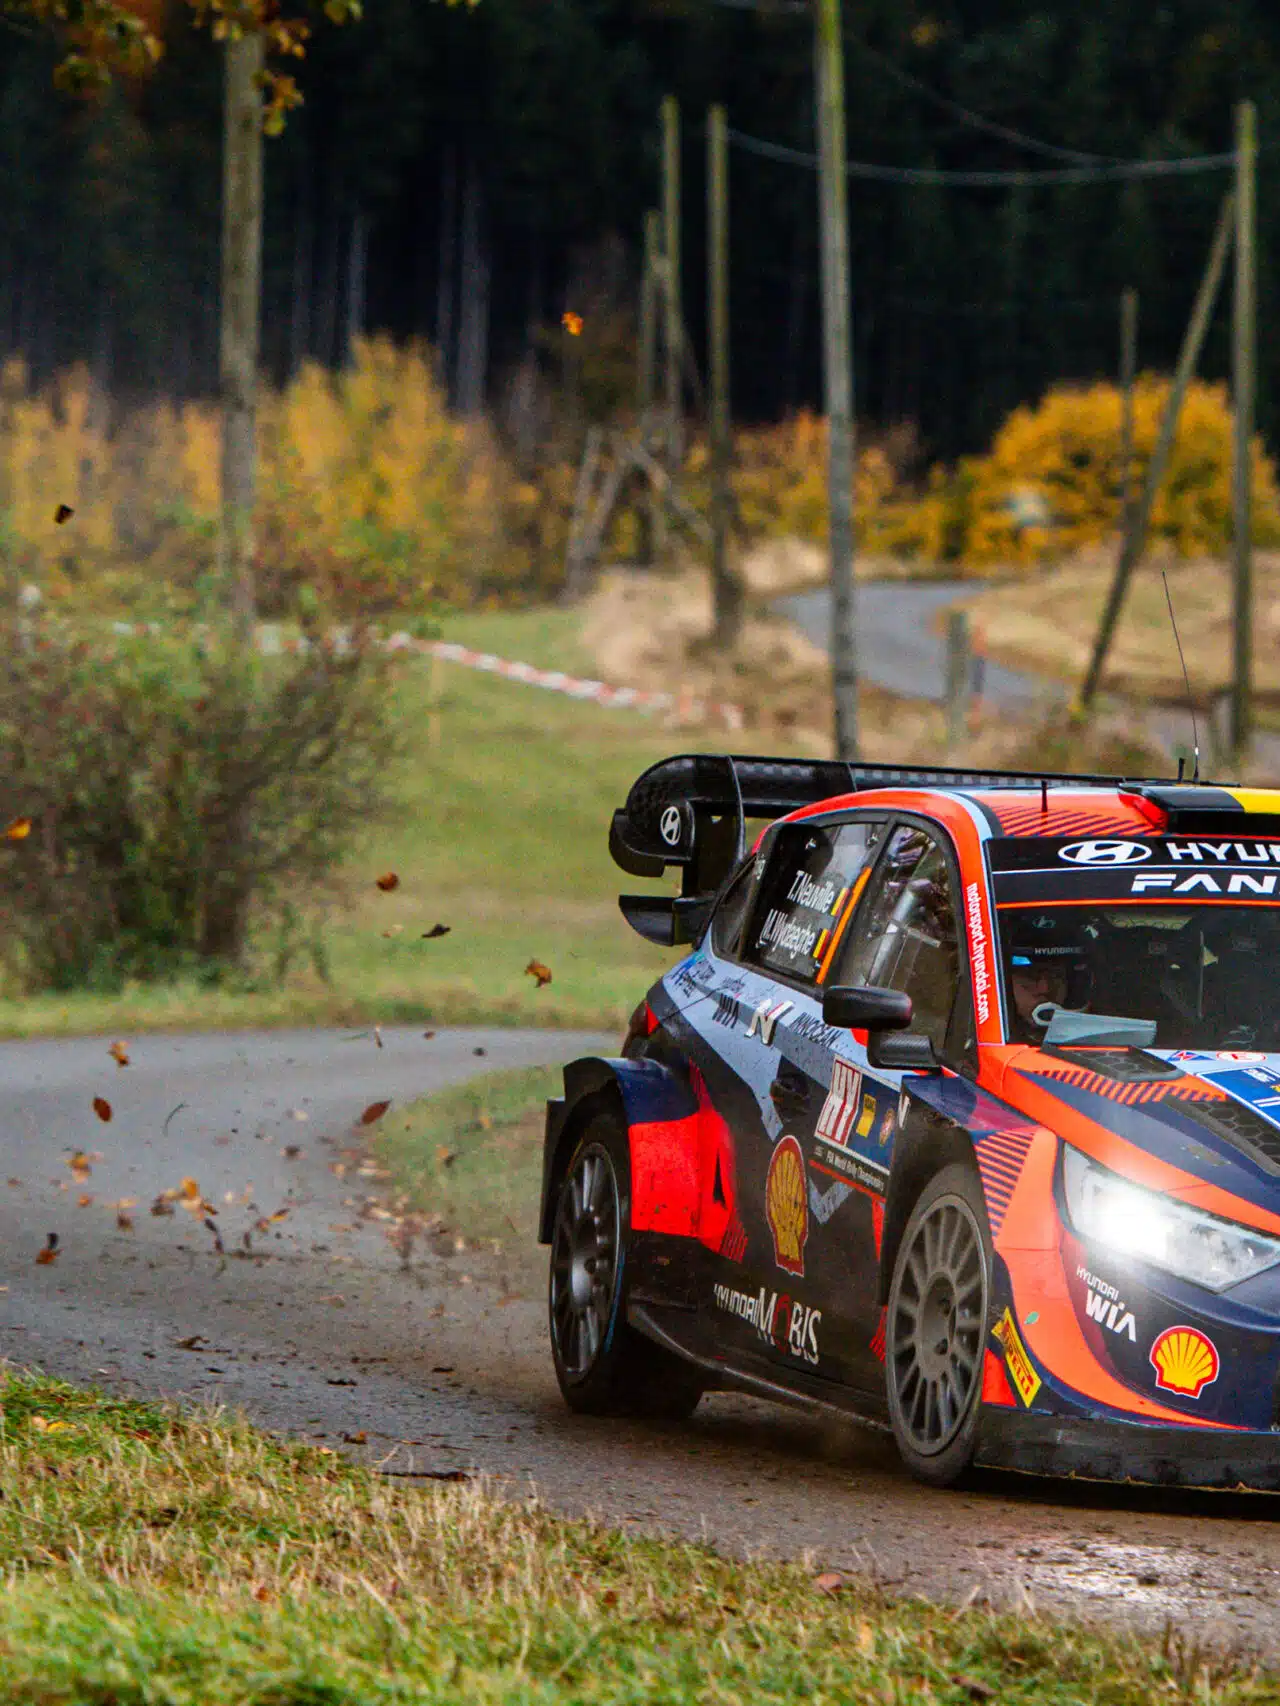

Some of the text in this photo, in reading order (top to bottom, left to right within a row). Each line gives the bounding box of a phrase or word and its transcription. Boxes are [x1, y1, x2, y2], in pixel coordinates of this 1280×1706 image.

[967, 882, 990, 1024] motorsport.hyundai.com
[1076, 1264, 1119, 1302] HYUNDAI
[1085, 1289, 1137, 1343] WIA
[713, 1283, 822, 1365] HYUNDAI MOBIS
